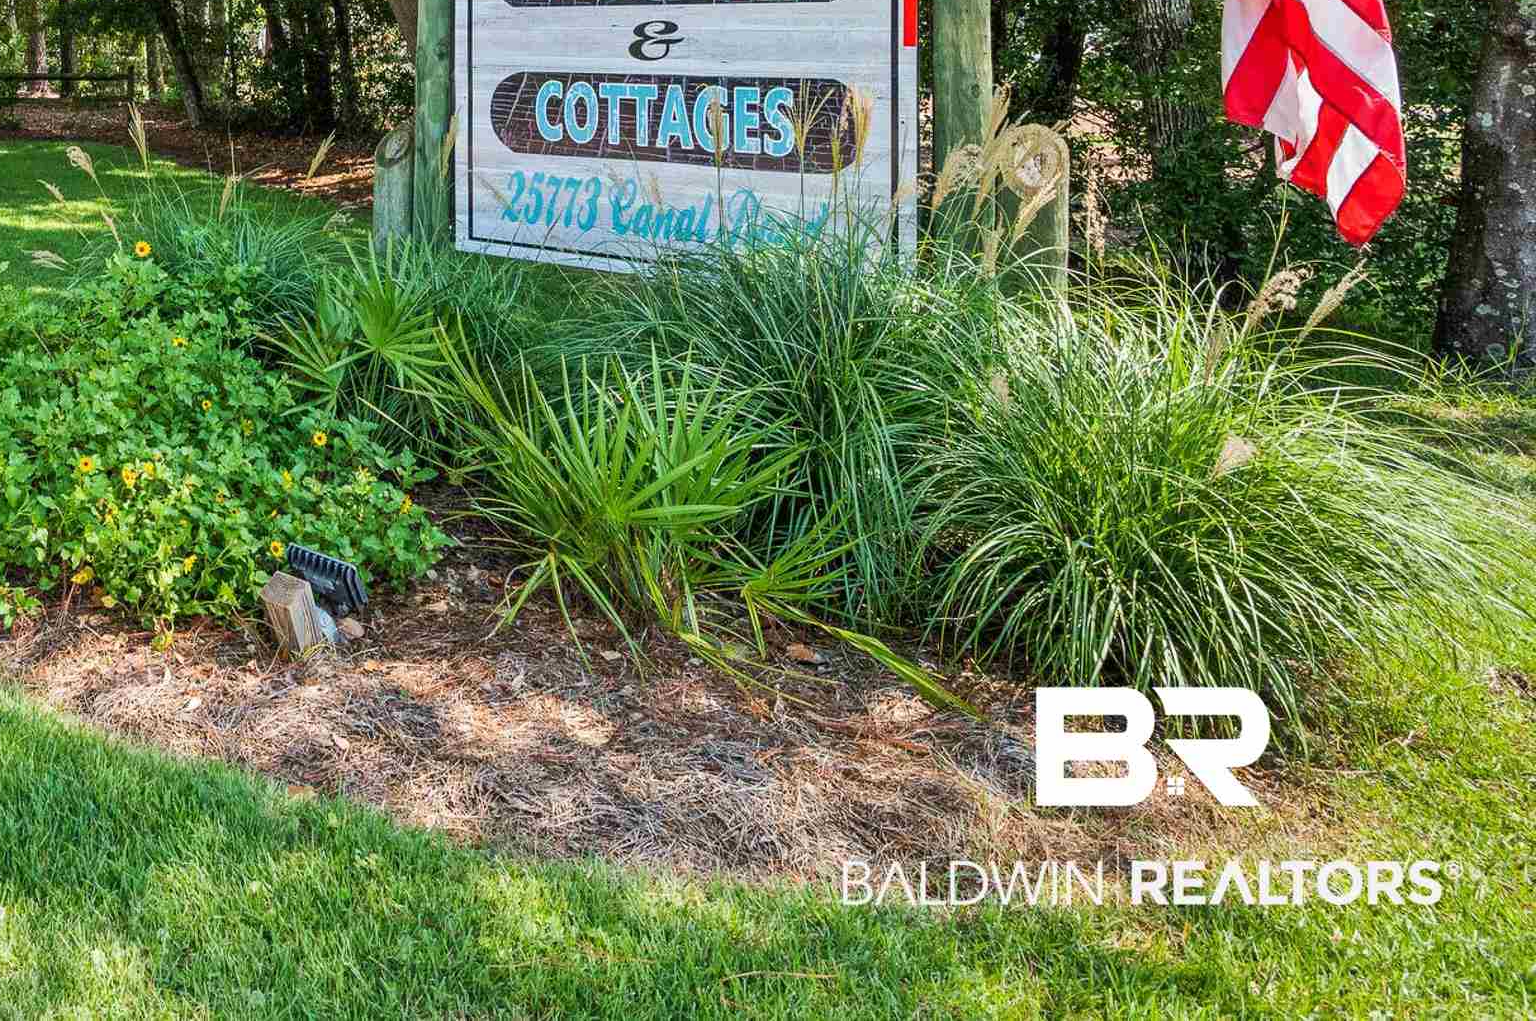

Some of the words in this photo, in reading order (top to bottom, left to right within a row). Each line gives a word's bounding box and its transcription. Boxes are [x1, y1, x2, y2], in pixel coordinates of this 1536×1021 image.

[627, 20, 685, 61] &
[534, 80, 796, 158] COTTAGES
[502, 170, 602, 233] 25773
[608, 178, 715, 244] Canal
